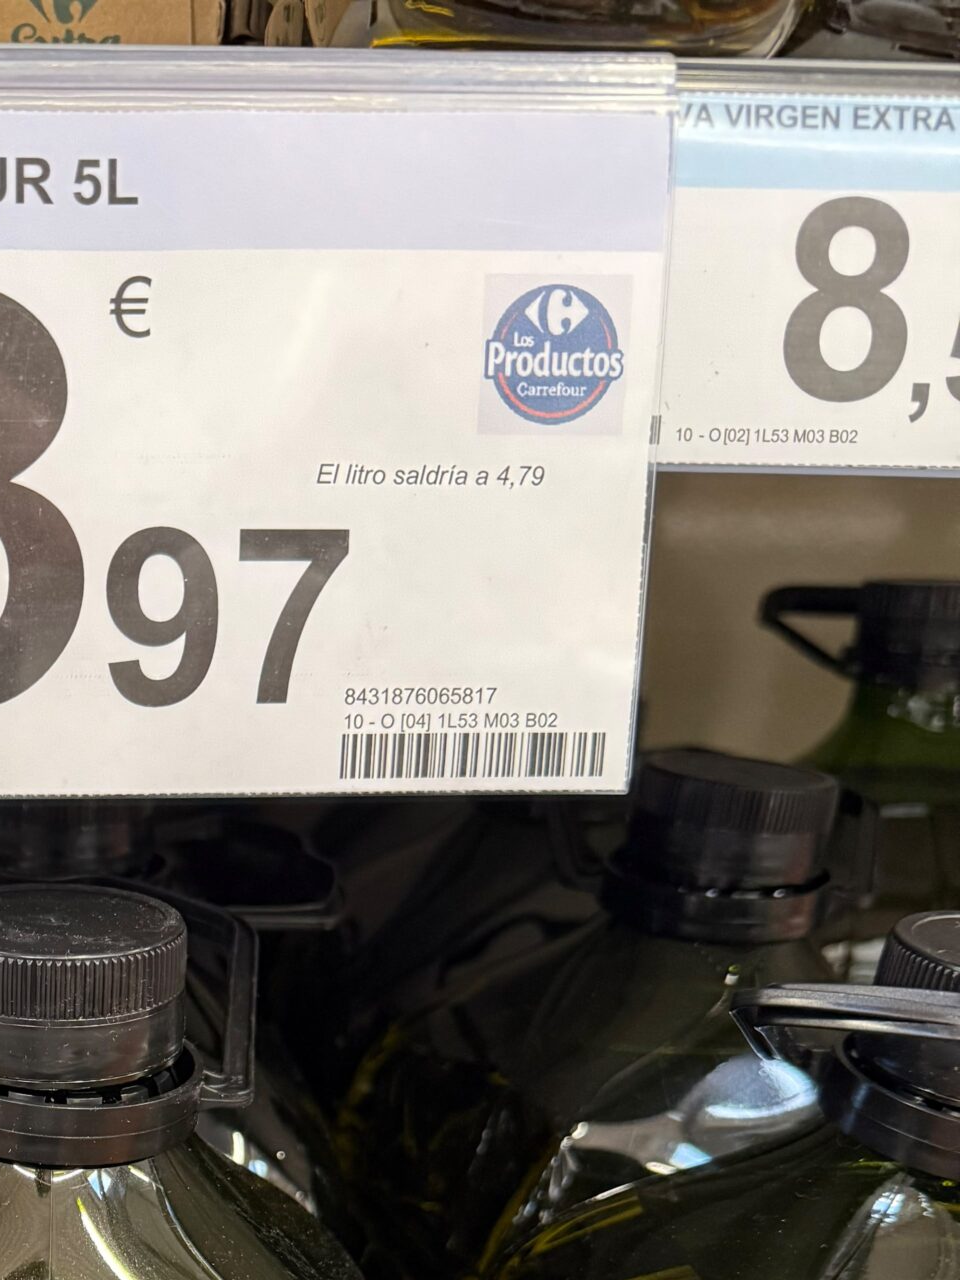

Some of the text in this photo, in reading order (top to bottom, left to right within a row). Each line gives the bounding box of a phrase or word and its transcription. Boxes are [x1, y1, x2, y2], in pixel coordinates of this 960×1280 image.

[724, 103, 840, 129] VIRGEN
[852, 105, 955, 131] EXTRA
[73, 158, 138, 206] 5L
[108, 275, 154, 338] €
[513, 332, 535, 347] Los
[487, 340, 624, 377] Productos
[517, 382, 587, 397] Carrefour
[676, 428, 693, 442] 10
[724, 428, 750, 445] [02]
[754, 428, 789, 443] 1L53
[793, 429, 825, 443] M03
[829, 429, 858, 443] B02
[316, 463, 545, 490] El litro saldría a 4,79
[106, 525, 351, 707] 97
[344, 687, 498, 705] 8431876065817
[344, 713, 364, 729] 10
[401, 713, 431, 731] [04]
[438, 713, 478, 728] 1L53
[484, 712, 520, 728] M03
[525, 712, 558, 728] B02
